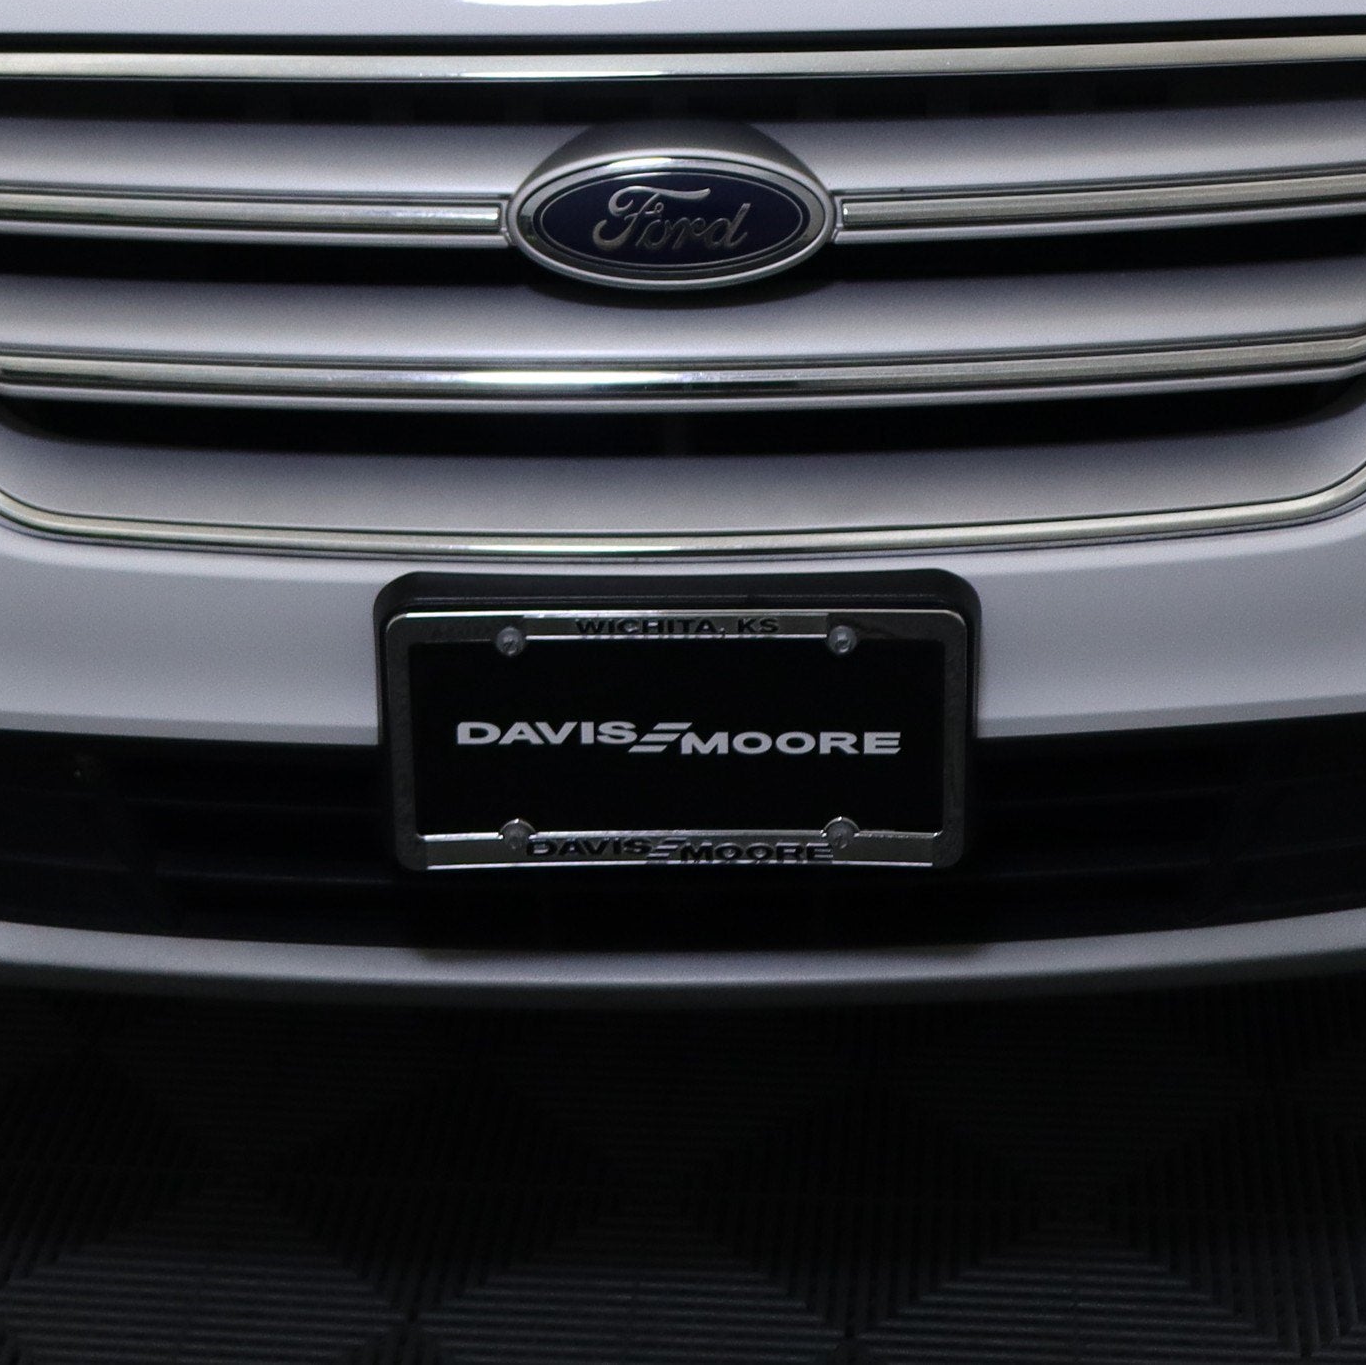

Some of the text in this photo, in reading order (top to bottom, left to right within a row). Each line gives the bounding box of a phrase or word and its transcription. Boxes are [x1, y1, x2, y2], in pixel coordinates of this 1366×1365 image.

[592, 185, 752, 251] Ford
[737, 618, 779, 634] KS
[456, 721, 902, 755] DAVIS MOORE
[526, 838, 834, 864] DAVIS MOORE
